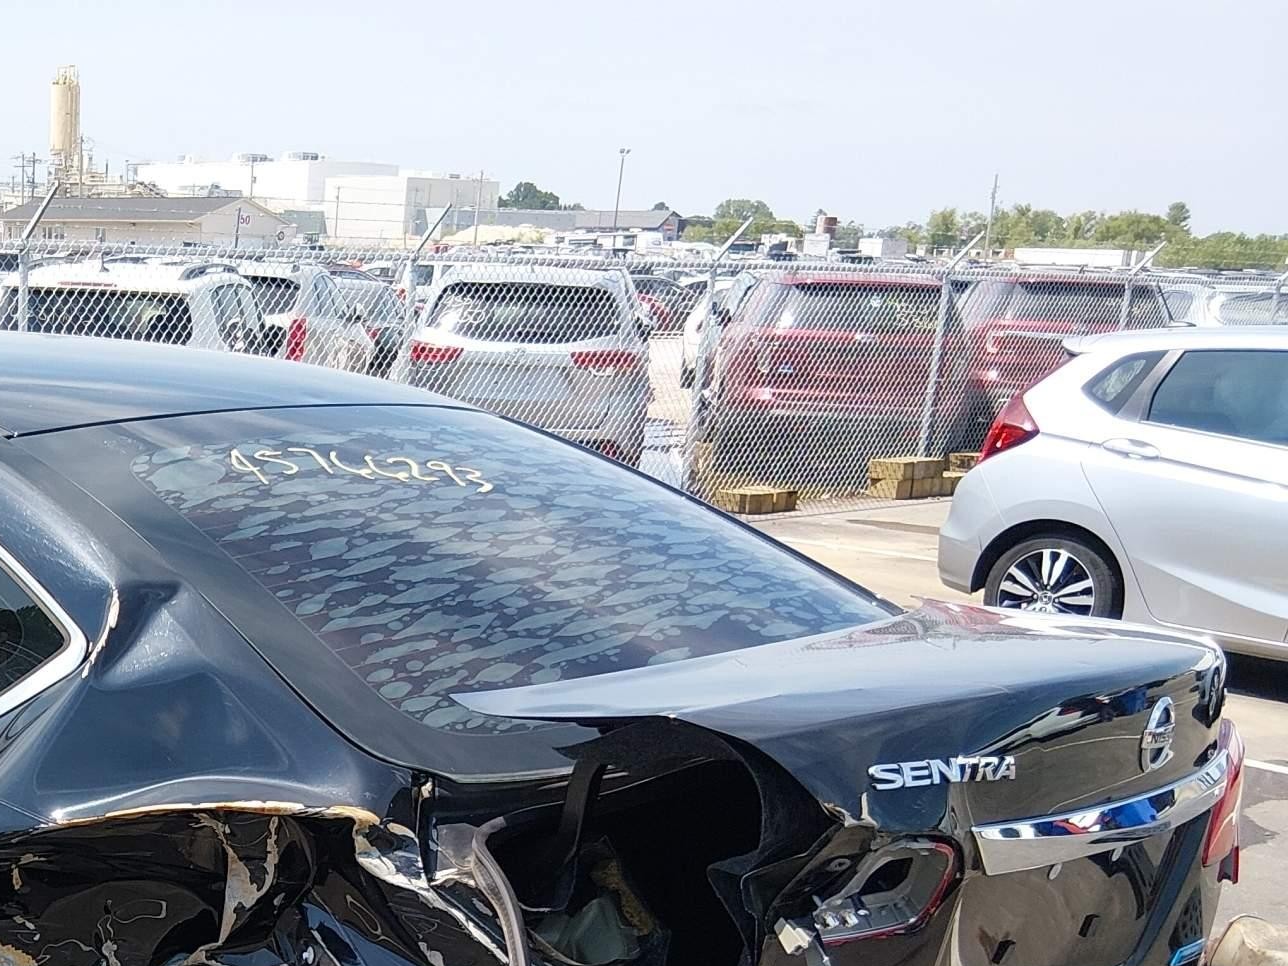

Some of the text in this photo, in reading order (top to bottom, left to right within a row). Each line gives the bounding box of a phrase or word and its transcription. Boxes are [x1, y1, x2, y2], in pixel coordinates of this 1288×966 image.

[240, 215, 251, 225] 50
[229, 447, 494, 494] 45766293
[867, 754, 1017, 791] SENTRA
